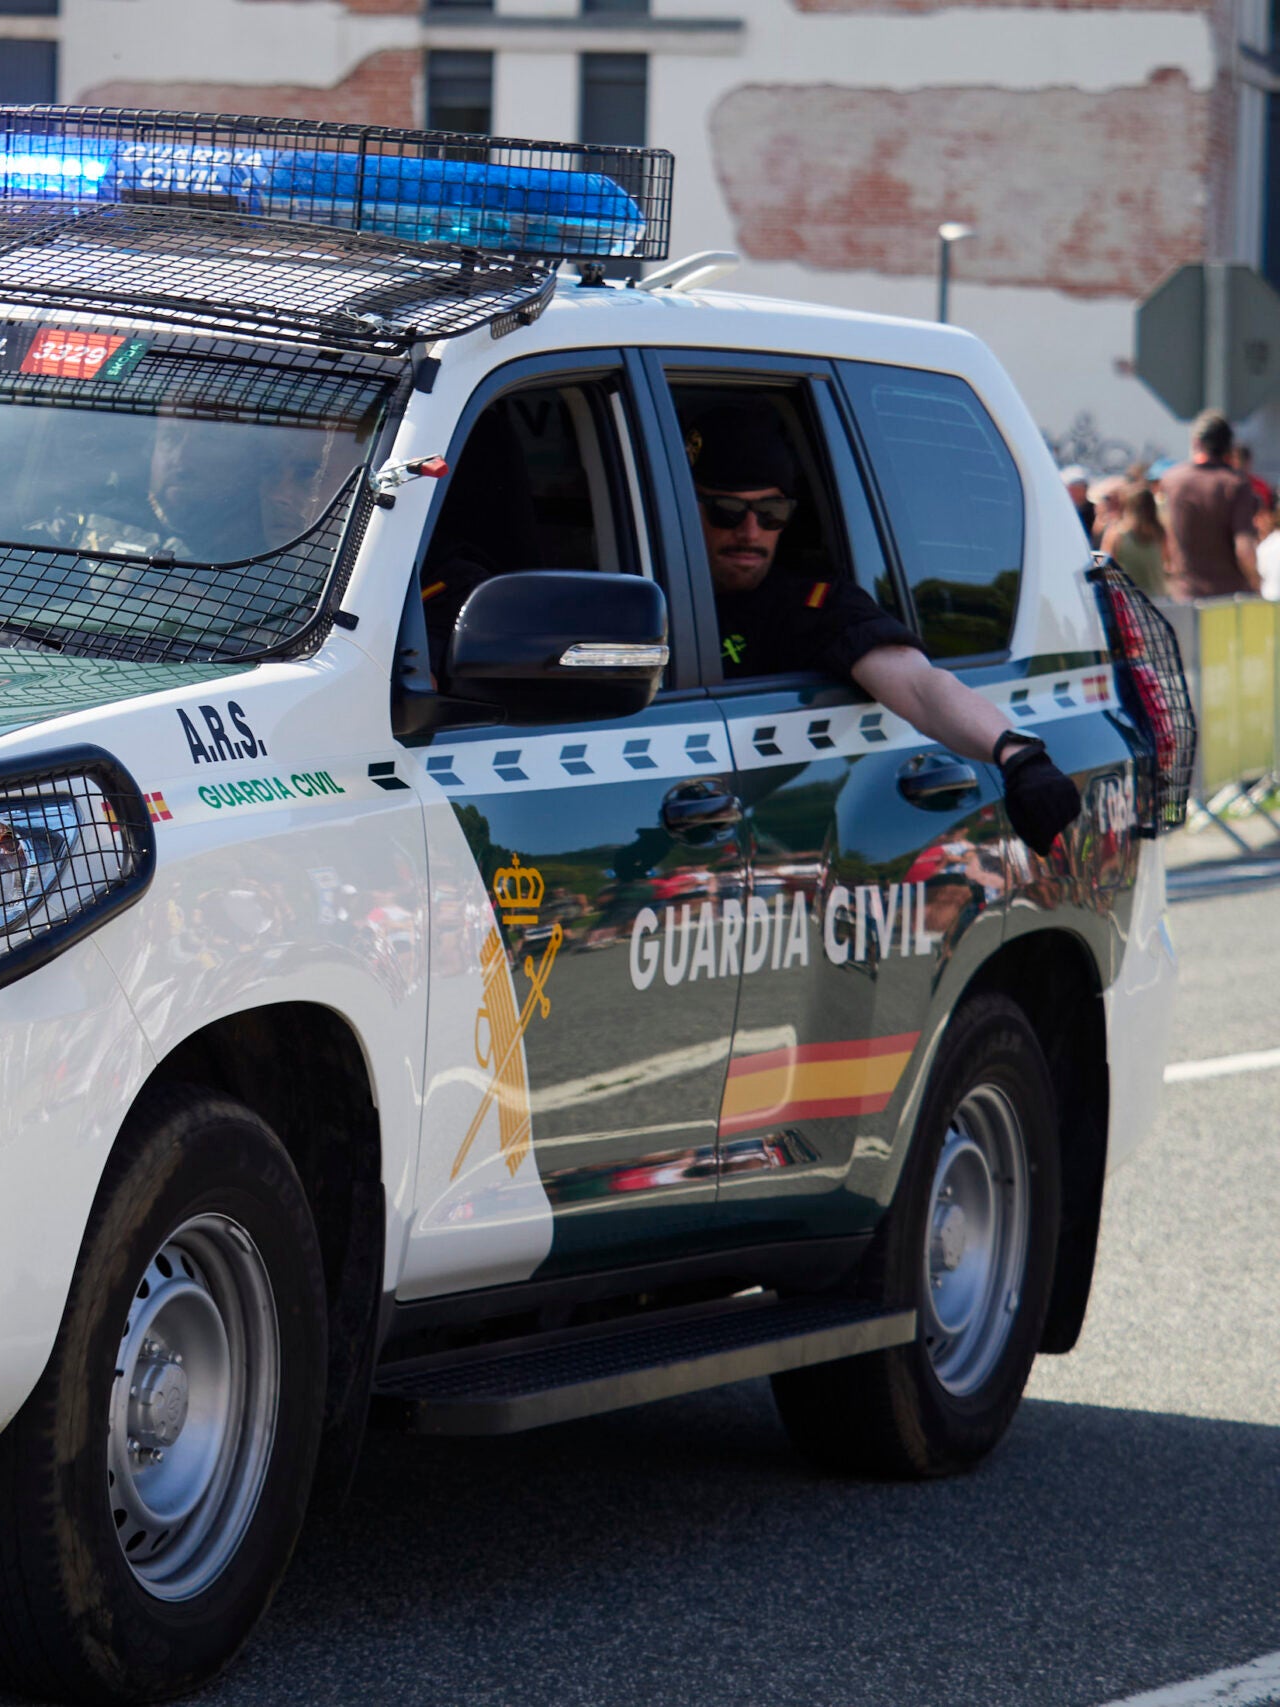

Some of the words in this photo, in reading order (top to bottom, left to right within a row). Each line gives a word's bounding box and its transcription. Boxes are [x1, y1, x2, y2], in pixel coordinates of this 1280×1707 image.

[122, 145, 262, 169] GUARDIA
[140, 167, 223, 191] CIVIL
[32, 341, 108, 364] 3329
[176, 700, 268, 764] A.R.S.
[198, 776, 296, 809] GUARDIA
[290, 771, 346, 797] CIVIL
[630, 891, 808, 991] GUARDIA
[824, 881, 932, 965] CIVIL
